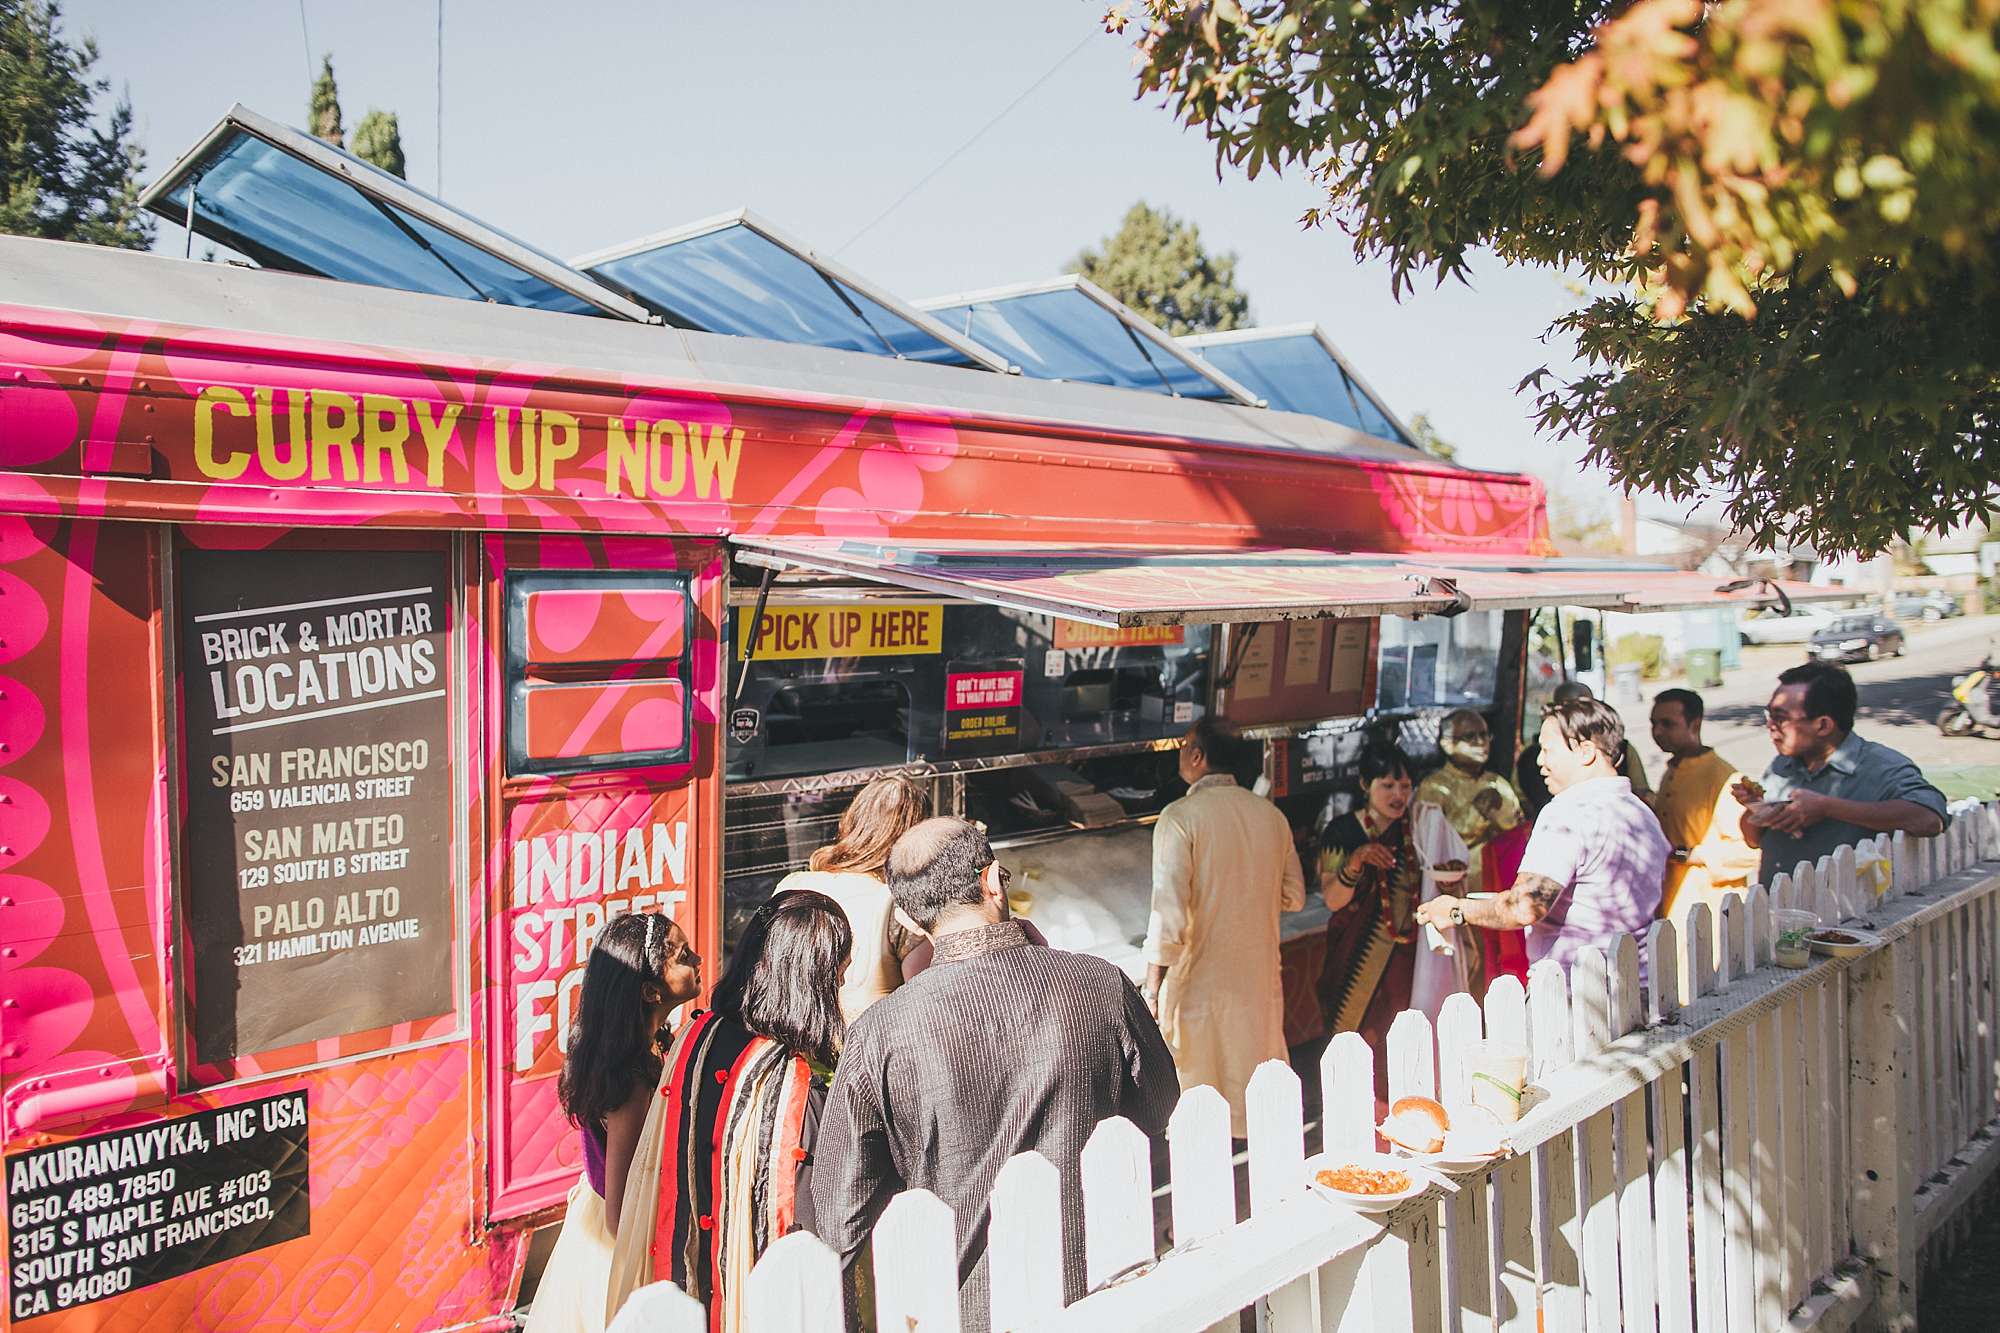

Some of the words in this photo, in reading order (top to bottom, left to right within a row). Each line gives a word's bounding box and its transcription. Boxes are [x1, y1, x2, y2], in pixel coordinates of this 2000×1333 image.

[194, 387, 464, 487] CURRY
[494, 406, 581, 491] UP
[606, 418, 745, 499] NOW
[202, 622, 289, 665] BRICK
[299, 621, 320, 652] &
[326, 603, 432, 647] MORTAR
[757, 611, 820, 651] PICK
[828, 609, 861, 648] UP
[870, 609, 929, 647] HERE
[211, 639, 436, 719] LOCATIONS
[956, 692, 965, 704] TO
[211, 753, 270, 787] SAN
[281, 739, 428, 783] FRANCISCO
[230, 790, 264, 812] 659
[269, 782, 351, 809] VALENCIA
[355, 776, 414, 801] STREET
[244, 826, 301, 862] SAN
[312, 814, 404, 855] MATEO
[239, 867, 268, 889] 129
[273, 859, 329, 885] SOUTH
[334, 856, 346, 877] B
[350, 848, 409, 874] STREET
[513, 821, 687, 908] INDIAN
[254, 897, 324, 937] PALO
[334, 886, 400, 925] ALTO
[233, 942, 262, 967] 321
[267, 929, 353, 961] HAMILTON
[358, 918, 419, 946] AVENUE
[10, 1121, 210, 1195] AKURANAVYKA,
[215, 1108, 256, 1146] INC
[262, 1097, 307, 1133] USA
[12, 1168, 176, 1229] 650.489.7850
[13, 1226, 55, 1258] 315
[62, 1219, 79, 1246] S
[86, 1199, 164, 1241] MAPLE
[170, 1185, 212, 1218] AVE
[218, 1170, 272, 1204] #103
[14, 1248, 95, 1288] SOUTH
[100, 1233, 148, 1267] SAN
[154, 1196, 275, 1252] FRANCISCO,
[15, 1291, 49, 1318] CA
[56, 1266, 132, 1308] 94080
